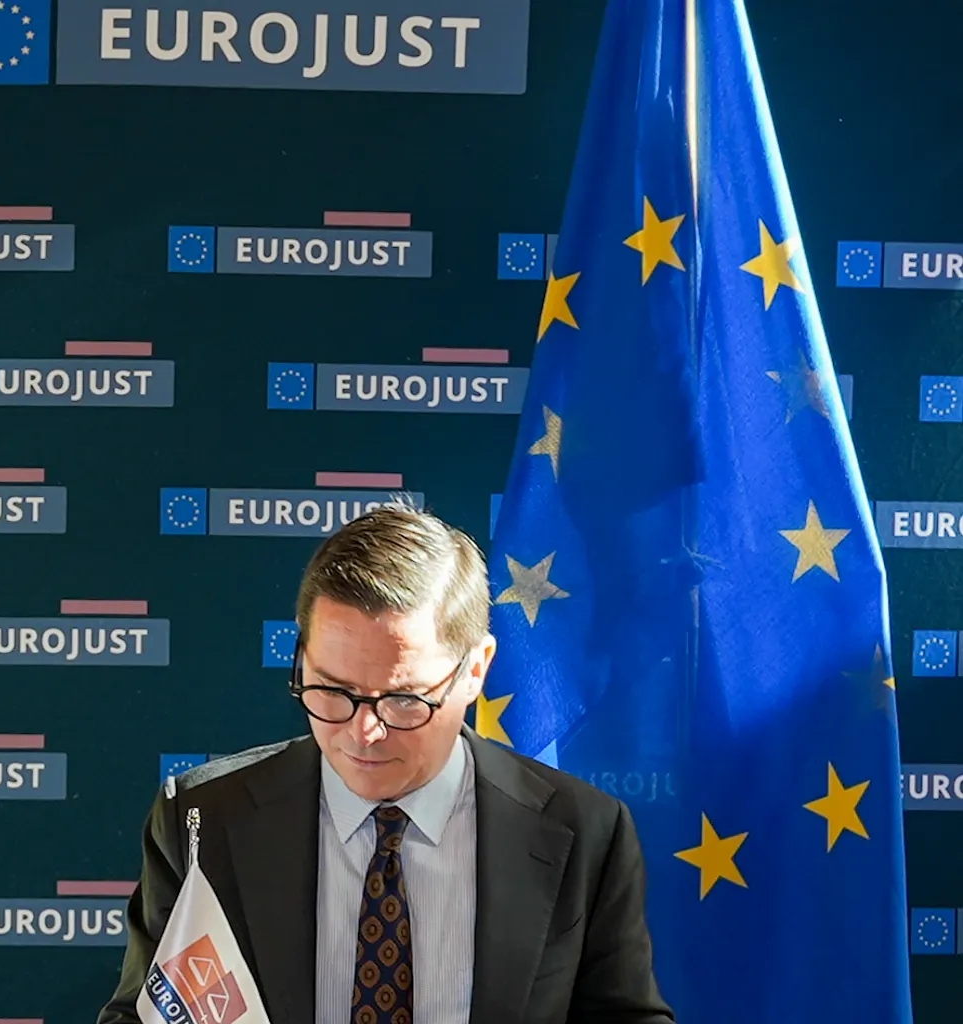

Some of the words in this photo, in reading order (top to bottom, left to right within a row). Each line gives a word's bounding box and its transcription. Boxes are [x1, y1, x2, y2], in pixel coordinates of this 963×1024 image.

[99, 8, 481, 78] EUROJUST
[236, 237, 411, 271] EUROJUST
[336, 374, 509, 408] EUROJUST
